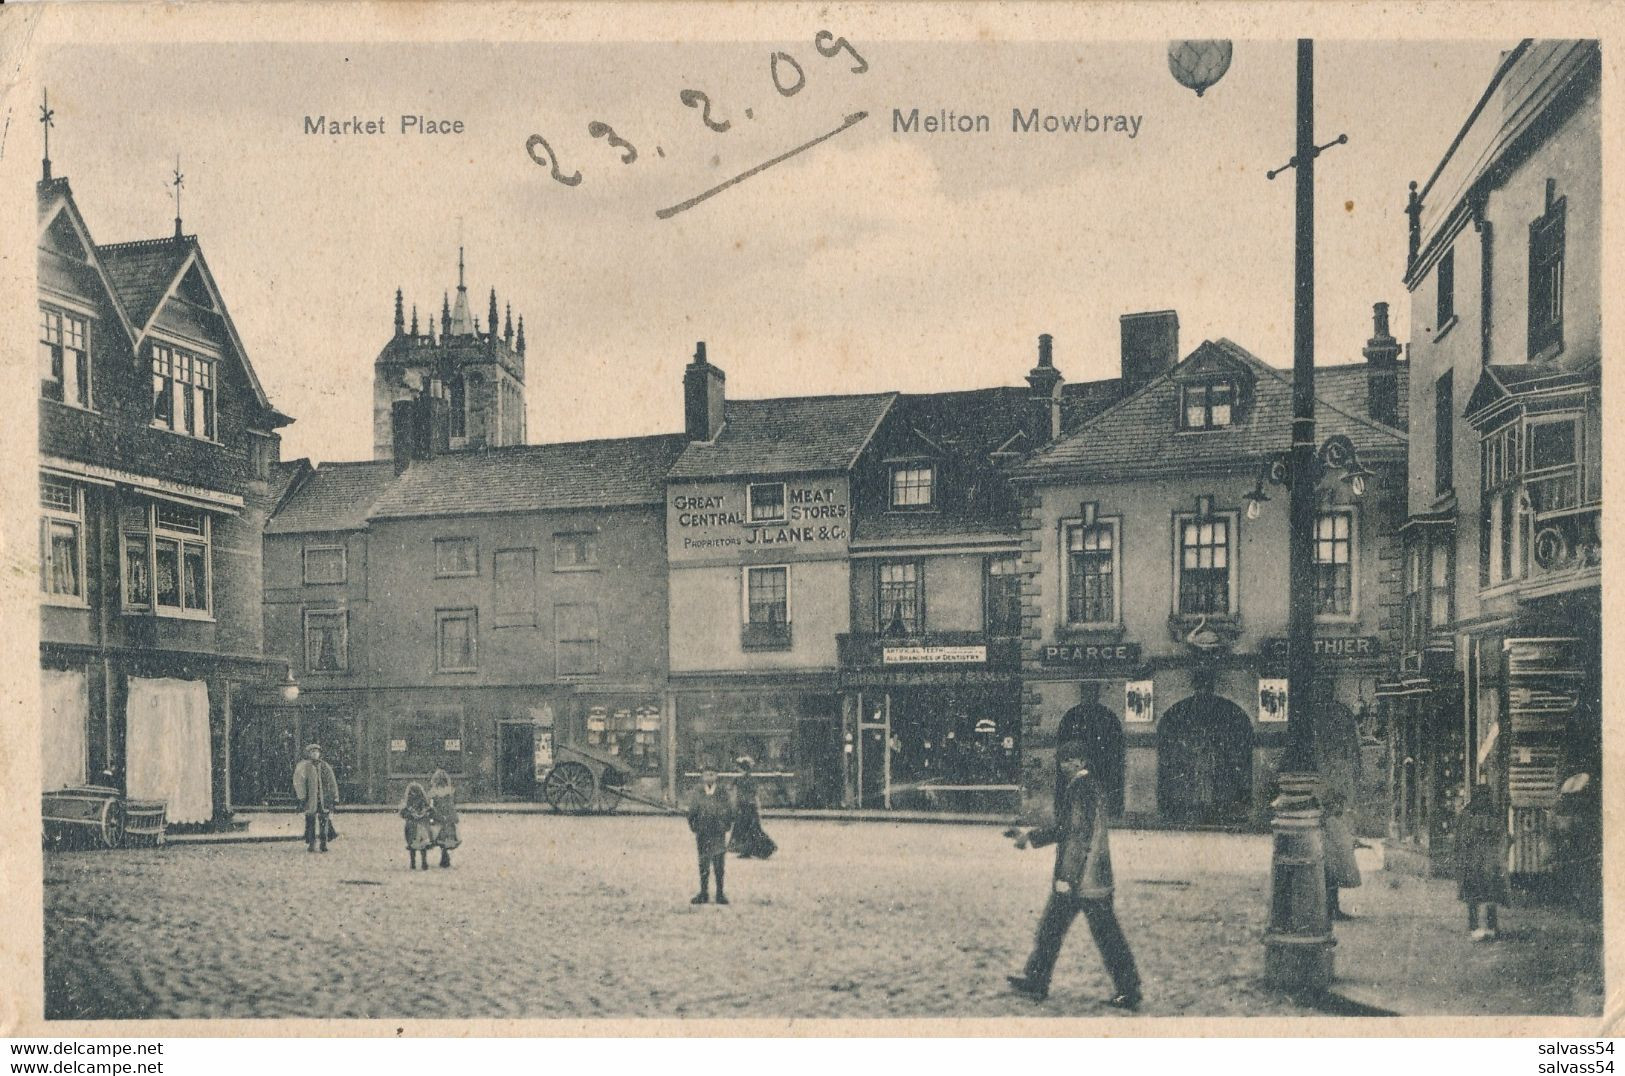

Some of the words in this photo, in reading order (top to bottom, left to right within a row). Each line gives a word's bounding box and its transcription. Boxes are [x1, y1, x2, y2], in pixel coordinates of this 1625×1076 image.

[673, 495, 724, 510] GREAT
[789, 489, 835, 503] MEAT
[679, 512, 745, 527] CENTRAL
[791, 504, 847, 520] STORES
[684, 537, 742, 549] PROPRIETORS
